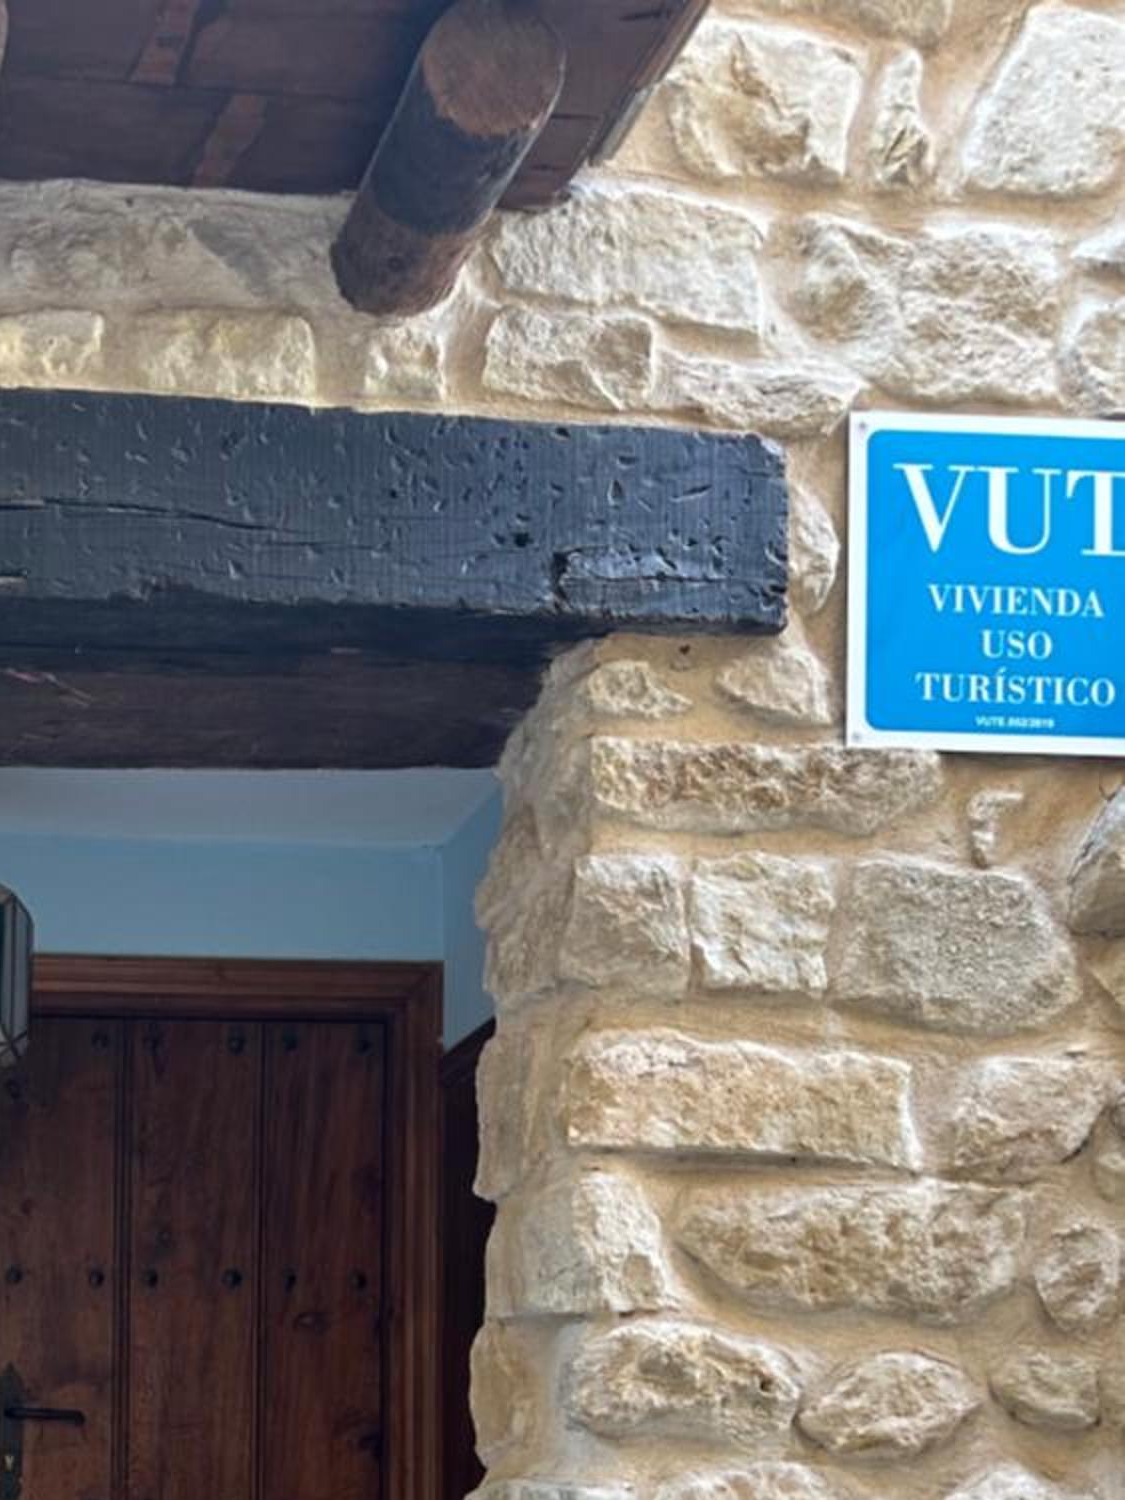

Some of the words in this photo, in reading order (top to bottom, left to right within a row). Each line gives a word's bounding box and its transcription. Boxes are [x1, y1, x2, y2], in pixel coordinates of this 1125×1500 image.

[893, 463, 1125, 557] VUT
[928, 583, 1105, 618] VIVIENDA
[981, 629, 1053, 659] USO
[915, 667, 1116, 706] TURÍSTICO
